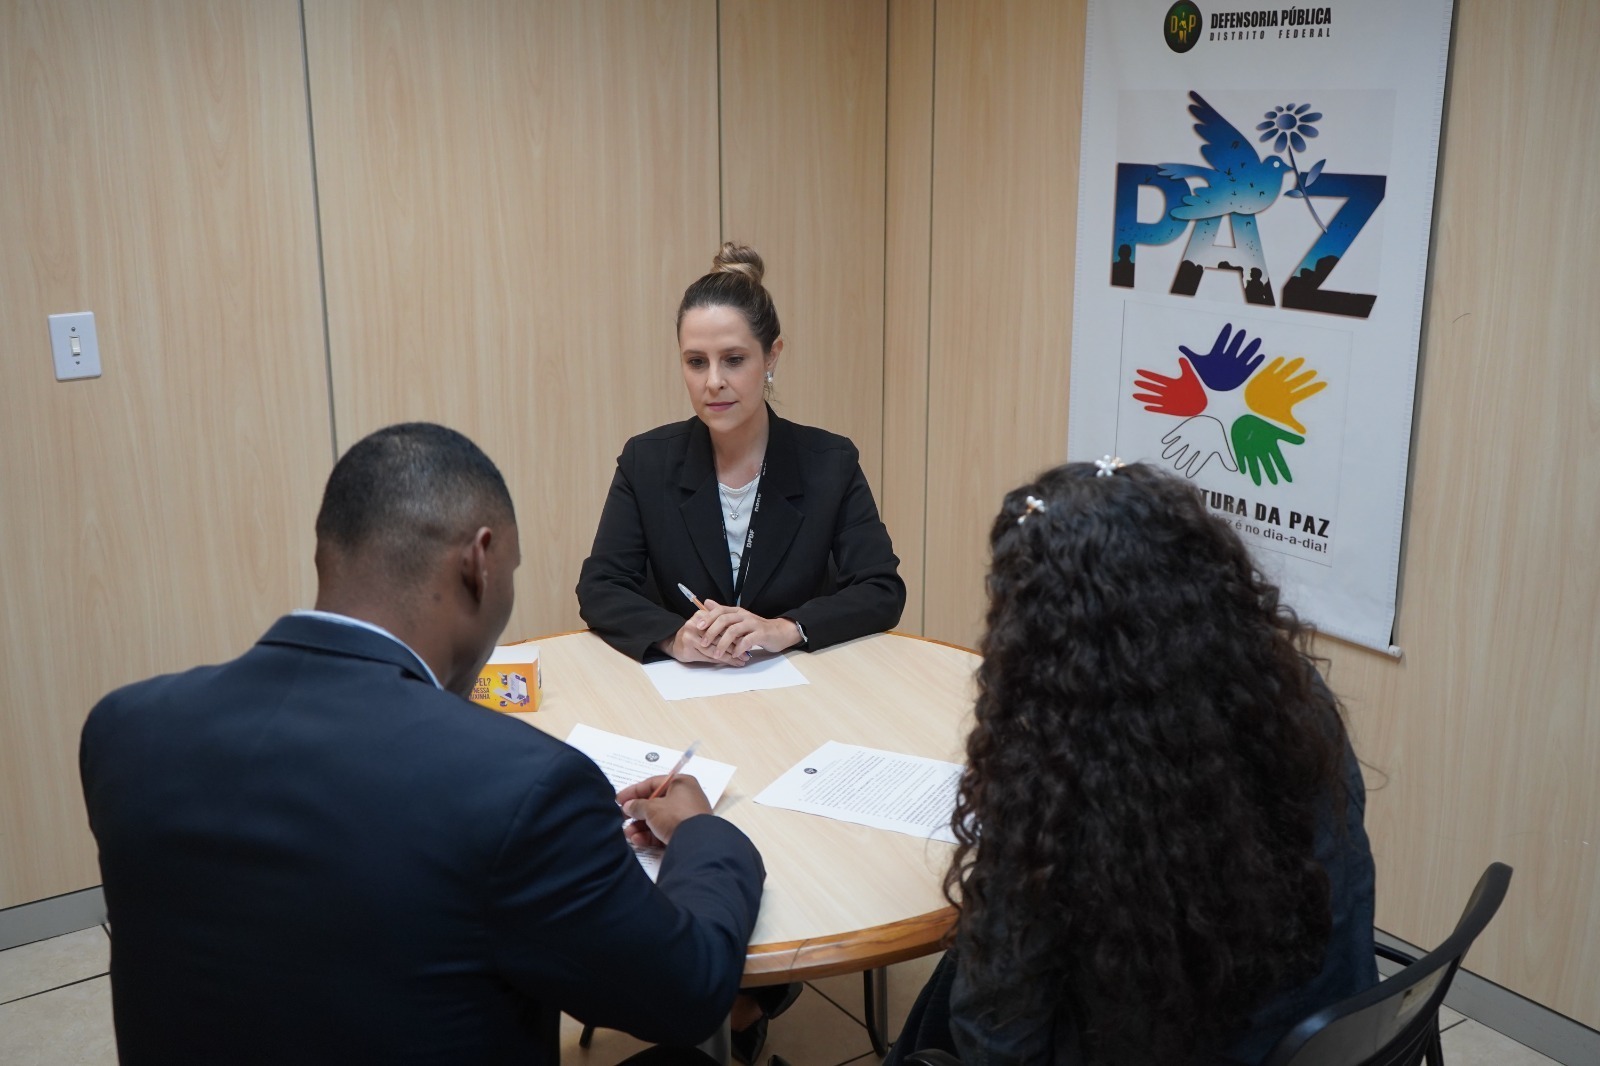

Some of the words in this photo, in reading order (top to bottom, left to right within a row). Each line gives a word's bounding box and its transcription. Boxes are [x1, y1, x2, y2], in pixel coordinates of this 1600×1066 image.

[1209, 30, 1265, 42] DISTRITO
[1278, 27, 1331, 39] FEDERAL
[1210, 10, 1278, 29] DEFENSORIA
[1280, 6, 1332, 27] PÚBLICA
[1109, 161, 1388, 320] PAZ
[1235, 519, 1242, 530] é
[1245, 524, 1260, 536] no
[1263, 527, 1328, 554] dia-a-dia!
[1255, 503, 1281, 526] DA
[1289, 511, 1330, 538] PAZ
